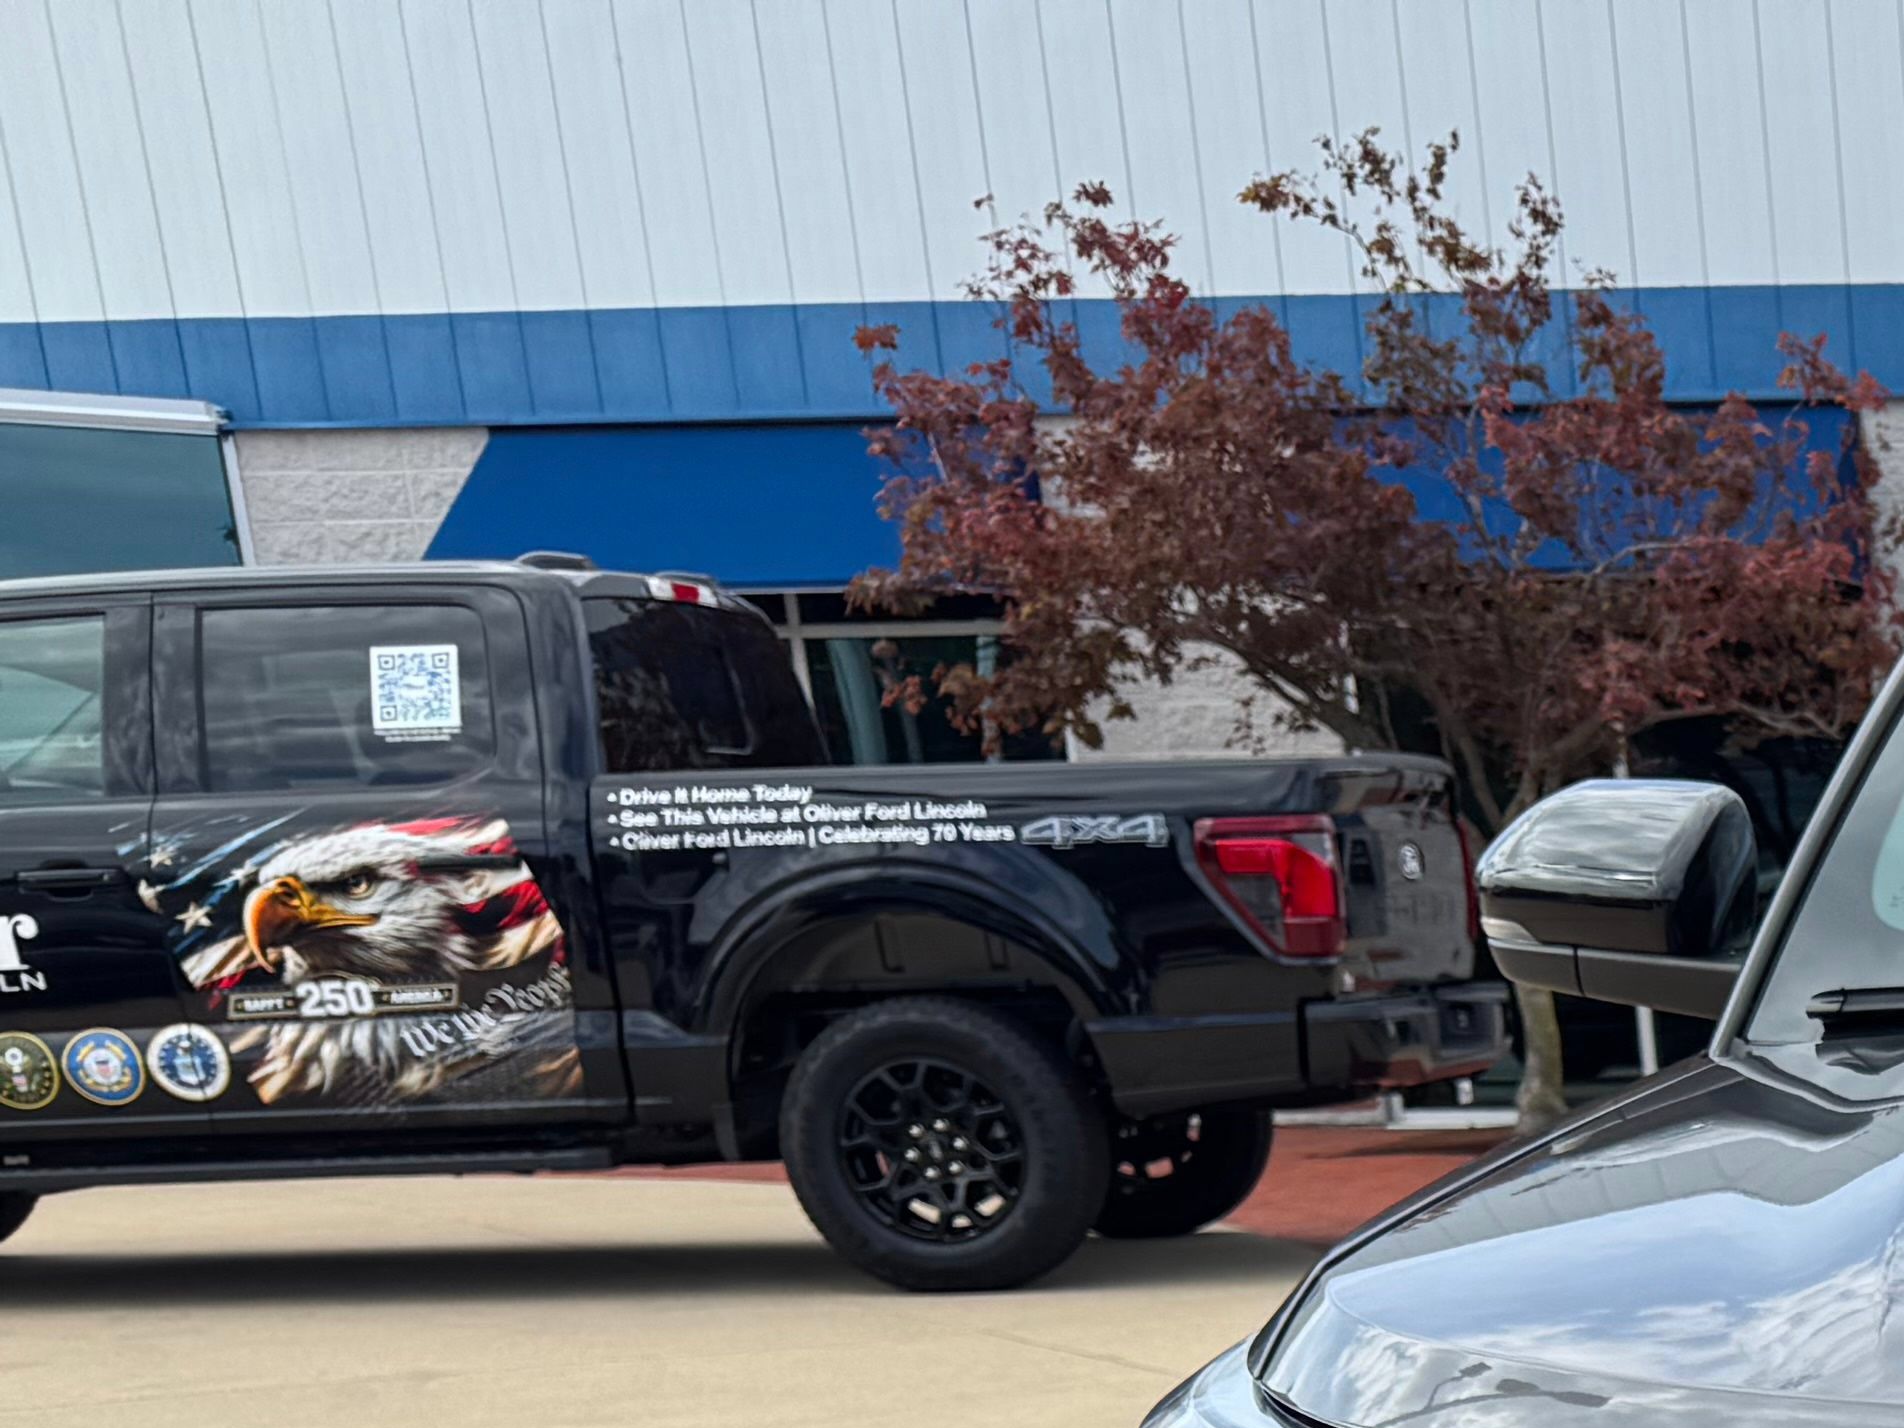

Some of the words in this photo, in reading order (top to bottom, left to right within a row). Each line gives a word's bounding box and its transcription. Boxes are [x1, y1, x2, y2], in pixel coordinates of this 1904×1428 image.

[619, 786, 672, 806] Drive
[674, 785, 689, 804] It
[691, 785, 751, 804] Home
[752, 783, 813, 805] Today
[619, 808, 659, 828] See
[660, 807, 705, 826] This
[706, 805, 778, 826] Vehicle
[780, 805, 800, 824] at
[803, 802, 862, 823] Oliver
[864, 801, 911, 821] Ford
[913, 799, 988, 821] Lincoln
[622, 831, 680, 851] Oliver
[682, 828, 731, 849] Ford
[732, 825, 806, 848] Lincoln
[817, 823, 930, 846] Celebrating
[931, 822, 958, 842] 70
[958, 821, 1016, 842] Years
[296, 980, 375, 1018] 250
